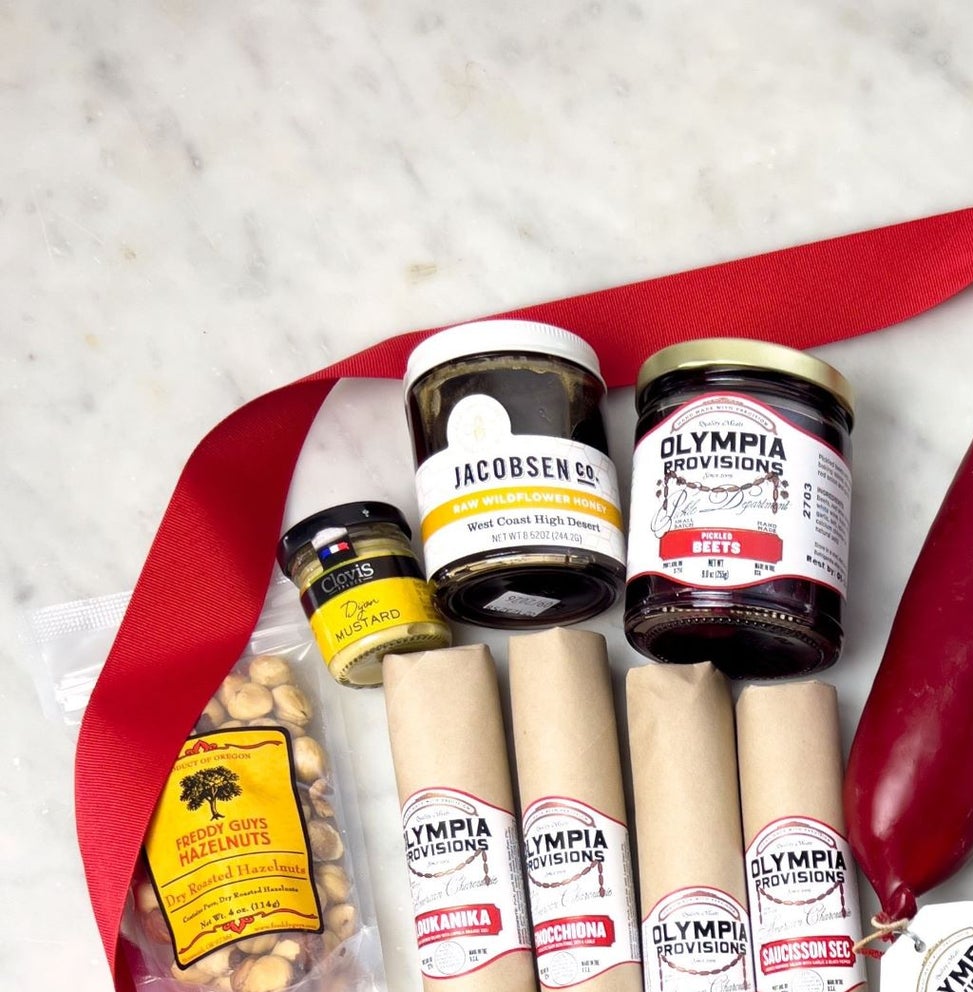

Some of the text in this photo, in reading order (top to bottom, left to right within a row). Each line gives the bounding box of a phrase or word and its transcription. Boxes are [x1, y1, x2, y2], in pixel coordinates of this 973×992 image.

[660, 431, 787, 461] OLYMPIA
[454, 456, 571, 489] JACOBSEN
[664, 455, 783, 476] PROVISIONS
[453, 491, 607, 514] RAW WILDFLOWER HONEY
[803, 483, 812, 519] 2703
[467, 514, 601, 533] West Coast High Desert
[701, 532, 733, 540] PICKLED
[693, 541, 741, 554] BEETS
[321, 562, 375, 593] Clovis
[336, 609, 401, 642] MUSTARD
[200, 752, 251, 765] OF OREGON
[176, 818, 268, 850] FREDDY GUYS
[404, 818, 492, 849] LYMPIA
[525, 829, 608, 857] LYMPIA
[179, 832, 271, 867] HAZELNUTS
[751, 850, 847, 878] OLYMPIA
[165, 859, 306, 908] Dry Roasted Hazelnuts
[755, 870, 845, 892] PROVISIONS
[417, 909, 491, 937] OUKANIKA
[652, 920, 748, 945] OLYMPIA
[657, 941, 747, 956] PROVISIONS
[762, 940, 851, 966] SAUCISSON SEC
